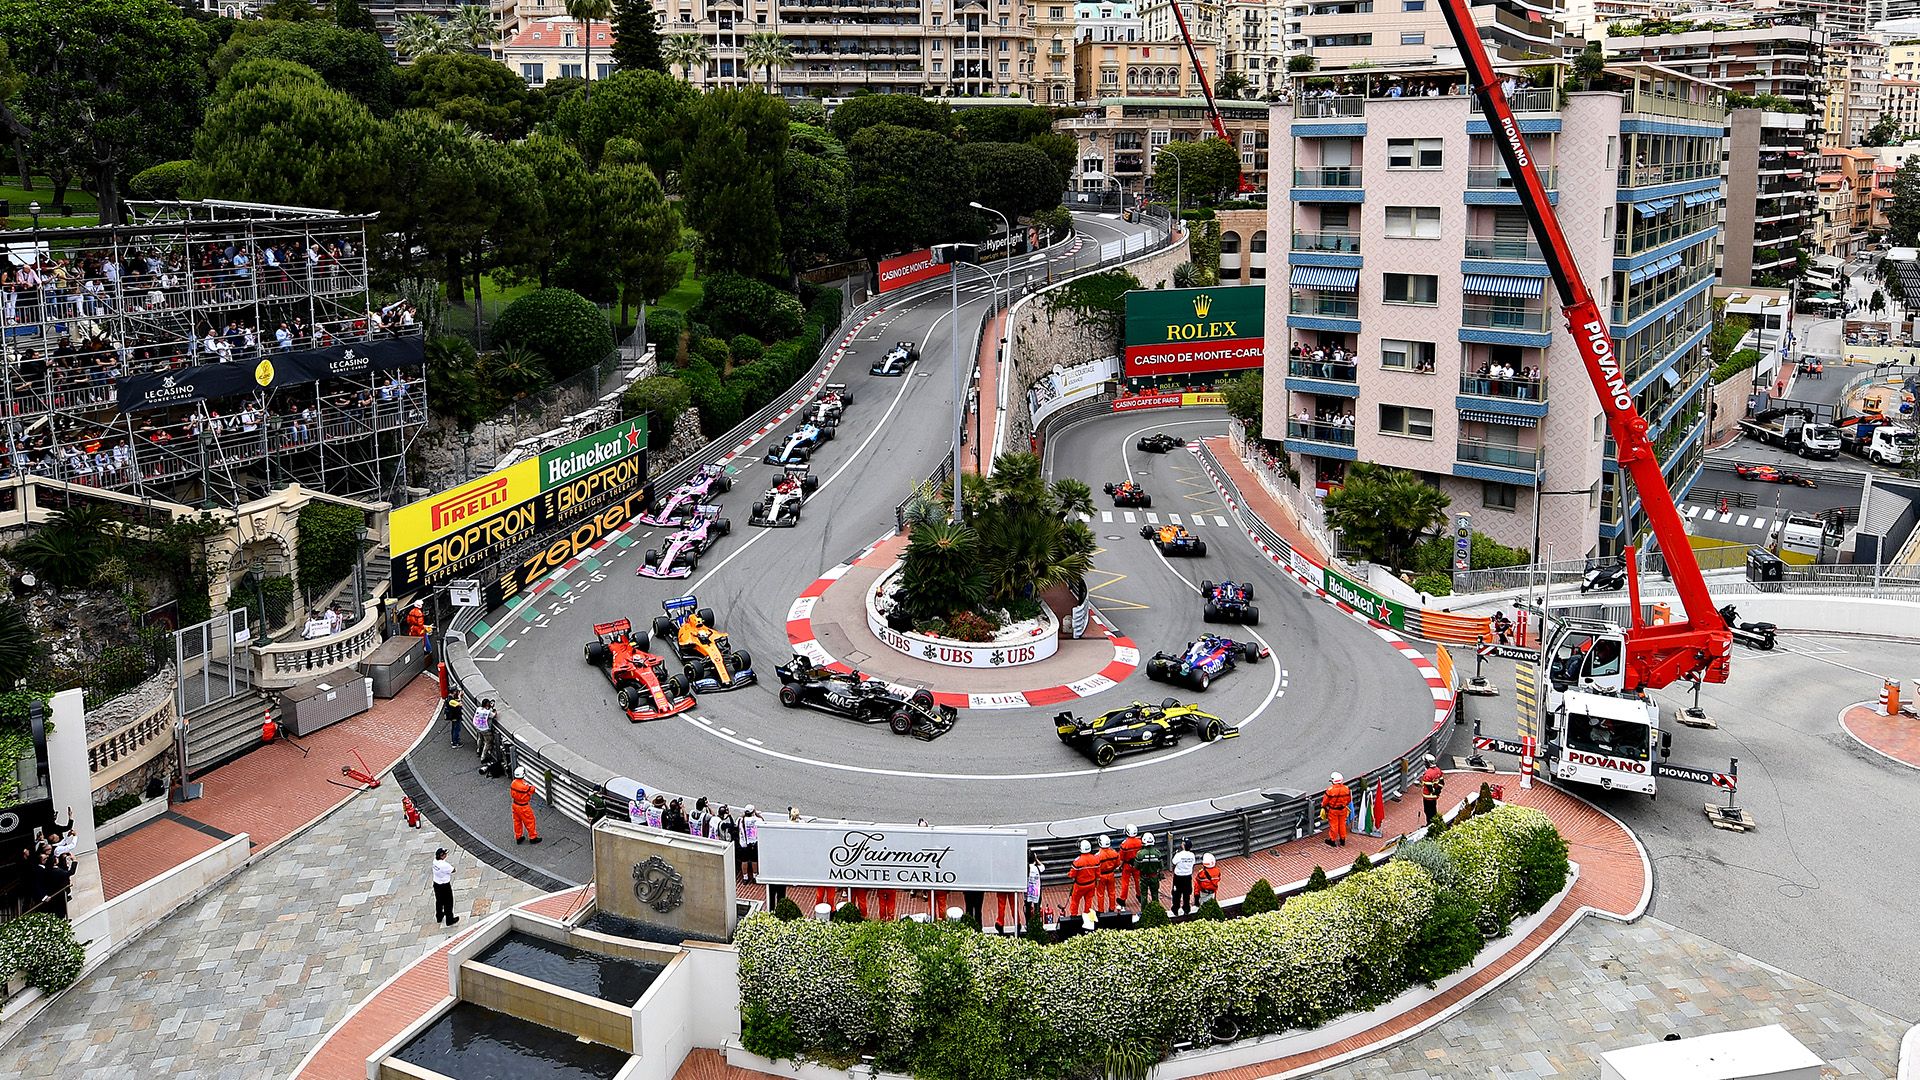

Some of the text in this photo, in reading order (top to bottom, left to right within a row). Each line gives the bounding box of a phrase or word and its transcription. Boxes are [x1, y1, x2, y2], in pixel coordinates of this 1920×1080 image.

[1502, 117, 1528, 167] PIOVANO
[881, 268, 902, 281] CASINO
[902, 265, 909, 276] DE
[1166, 321, 1237, 340] ROLEX
[339, 357, 369, 367] CASINO
[1134, 354, 1175, 366] CASINO
[1177, 352, 1192, 362] DE
[1583, 320, 1632, 411] PIOVANO
[145, 385, 194, 399] LE CASINO
[548, 438, 621, 484] Heineken
[558, 455, 639, 511] BIOPTRON
[431, 477, 507, 531] PIRELLI
[558, 478, 638, 520] HYPERLIGHT THERAPY
[424, 501, 535, 573] BIOPTRON
[524, 490, 643, 584] zepter
[424, 528, 535, 586] HYPERLIGHT THERAPY
[1328, 575, 1374, 615] Heineken
[887, 632, 910, 651] UBS
[939, 647, 973, 663] UBS
[1007, 647, 1035, 663] UBS
[1498, 648, 1539, 660] PIOVANO
[991, 695, 1024, 704] UBS
[1569, 752, 1645, 773] PIOVANO
[1659, 767, 1708, 782] PIOVANO
[829, 830, 954, 868] Fairmont
[828, 868, 957, 883] MONTE CARLO
